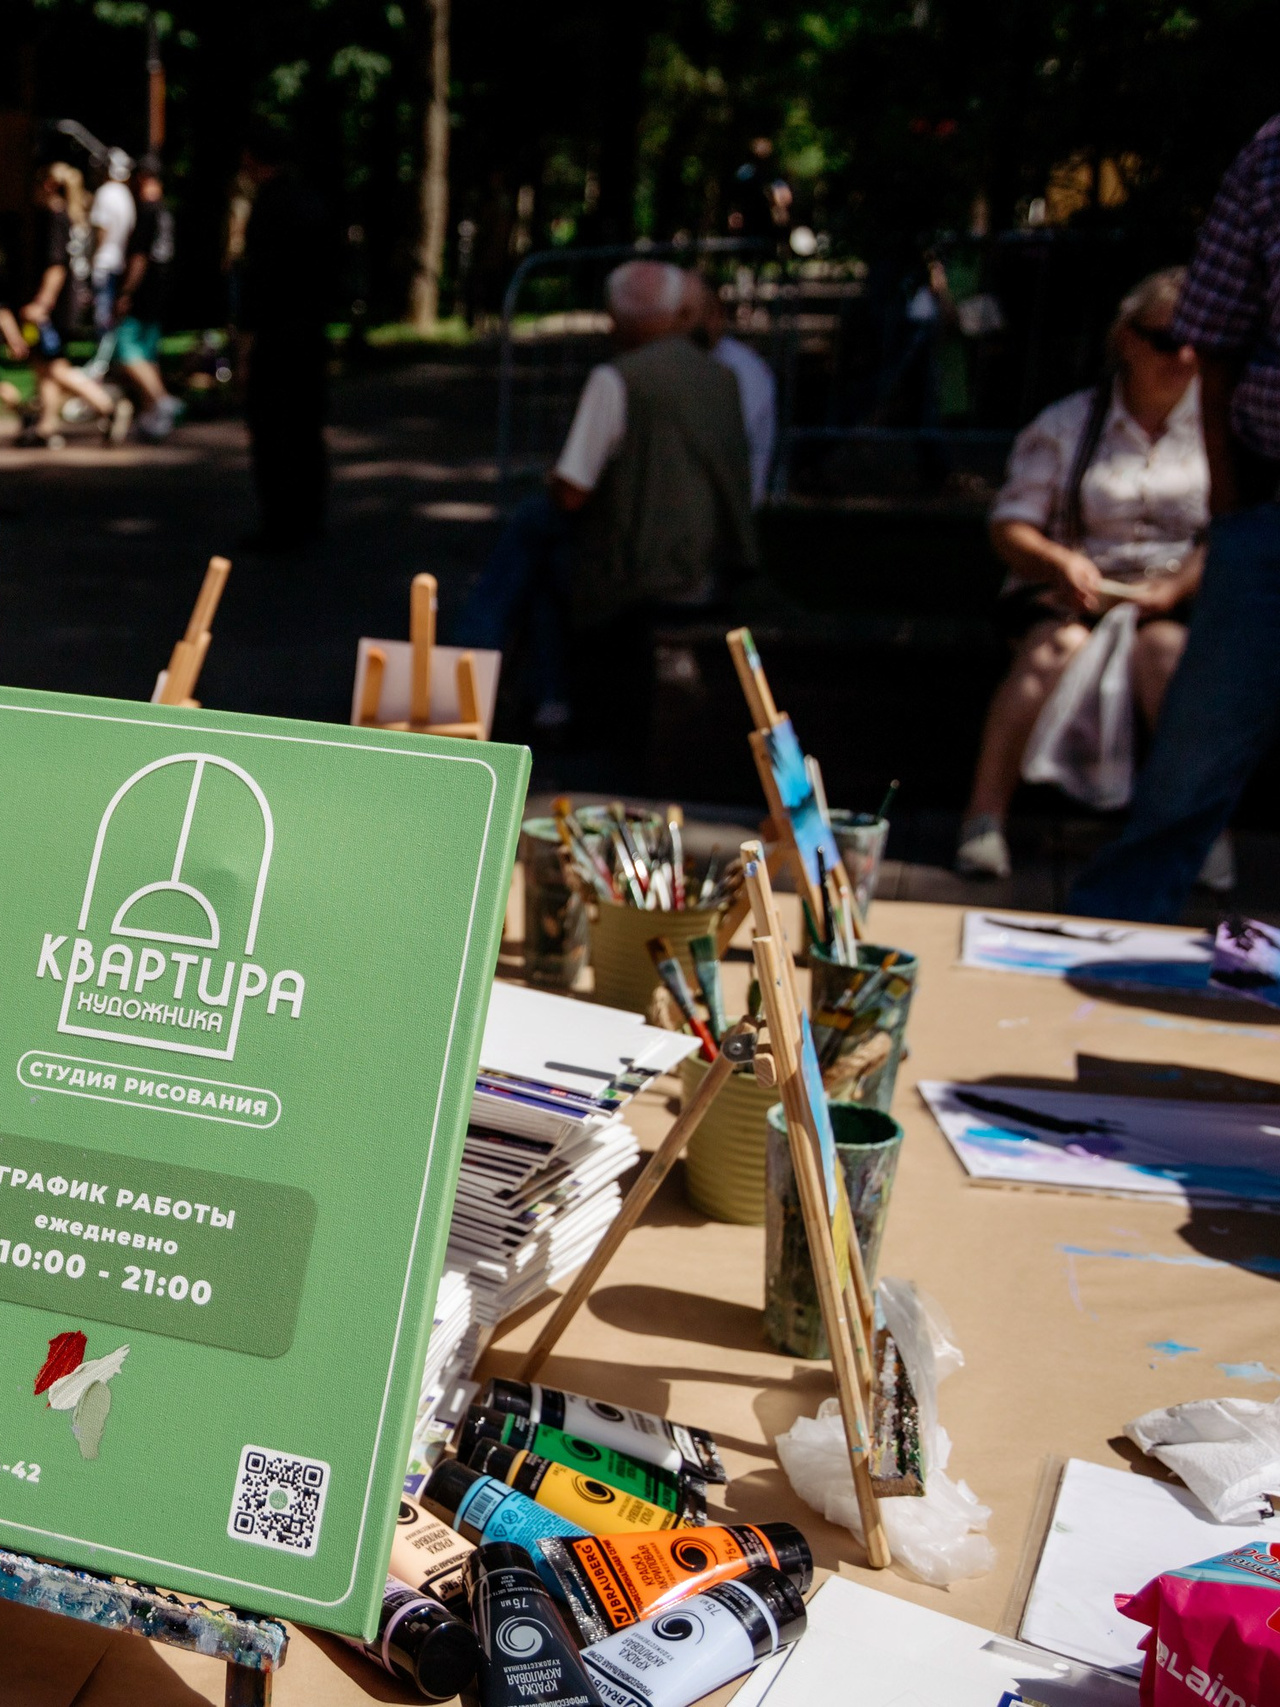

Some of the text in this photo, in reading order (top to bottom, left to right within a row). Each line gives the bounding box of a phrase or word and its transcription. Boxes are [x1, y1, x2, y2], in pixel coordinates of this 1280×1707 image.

[35, 932, 306, 1019] КВАРТИРА
[76, 991, 223, 1034] ХУДОЖНИКА
[29, 1061, 267, 1118] СТУДИЯ РИСОВАНИЯ
[115, 1188, 236, 1230] РАБОТЫ
[34, 1214, 179, 1255] ежедневно
[121, 1265, 213, 1306] 21:00
[631, 1553, 656, 1587] КРАСКА
[725, 1548, 740, 1561] 75
[581, 1544, 621, 1607] BRAUBERG
[500, 1597, 529, 1609] 75 мл
[704, 1602, 721, 1616] 75
[503, 1659, 561, 1673] ХУДОЖЕСТВЕННАЯ
[618, 1647, 652, 1672] КРАСКА
[621, 1637, 667, 1668] АКРИЛОВАЯ
[506, 1667, 562, 1686] АКРИЛОВАЯ
[517, 1680, 559, 1696] КРАСКА
